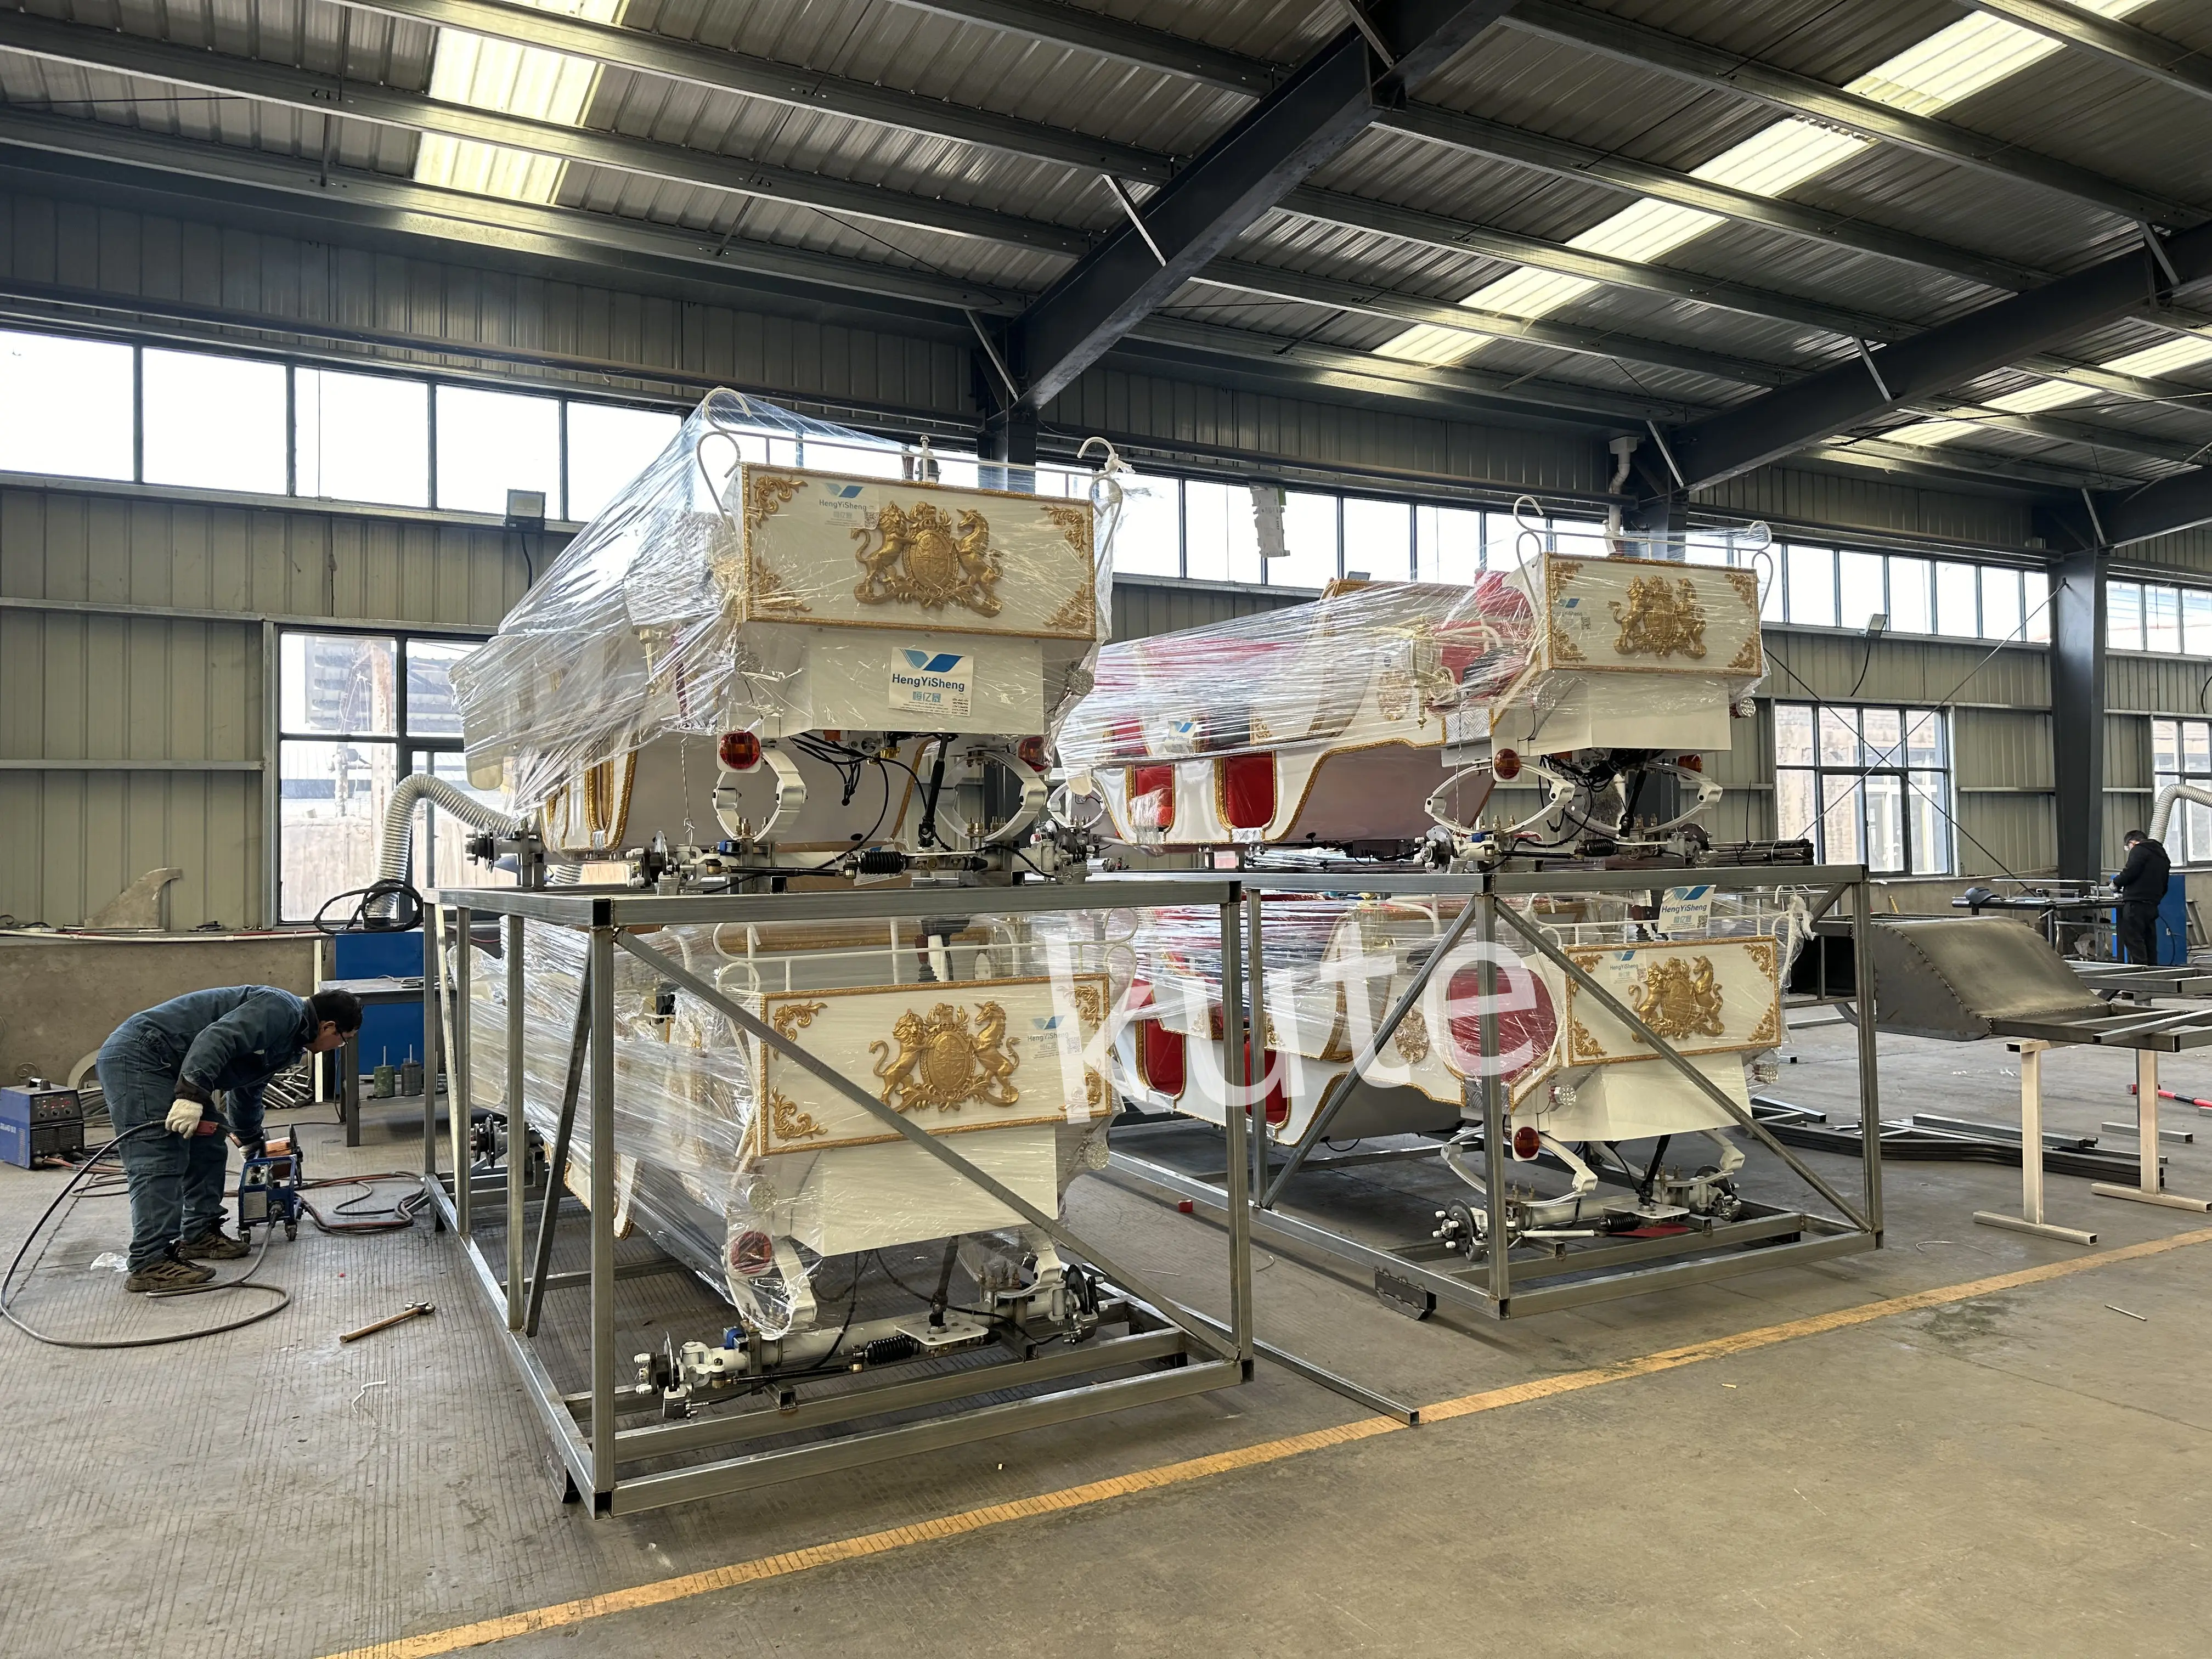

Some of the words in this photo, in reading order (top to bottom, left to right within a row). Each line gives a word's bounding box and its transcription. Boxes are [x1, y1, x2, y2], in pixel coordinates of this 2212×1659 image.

[819, 499, 867, 511] HengYiSheng
[892, 673, 965, 692] HengYiSheng
[1661, 904, 1707, 913] HengYiSheng
